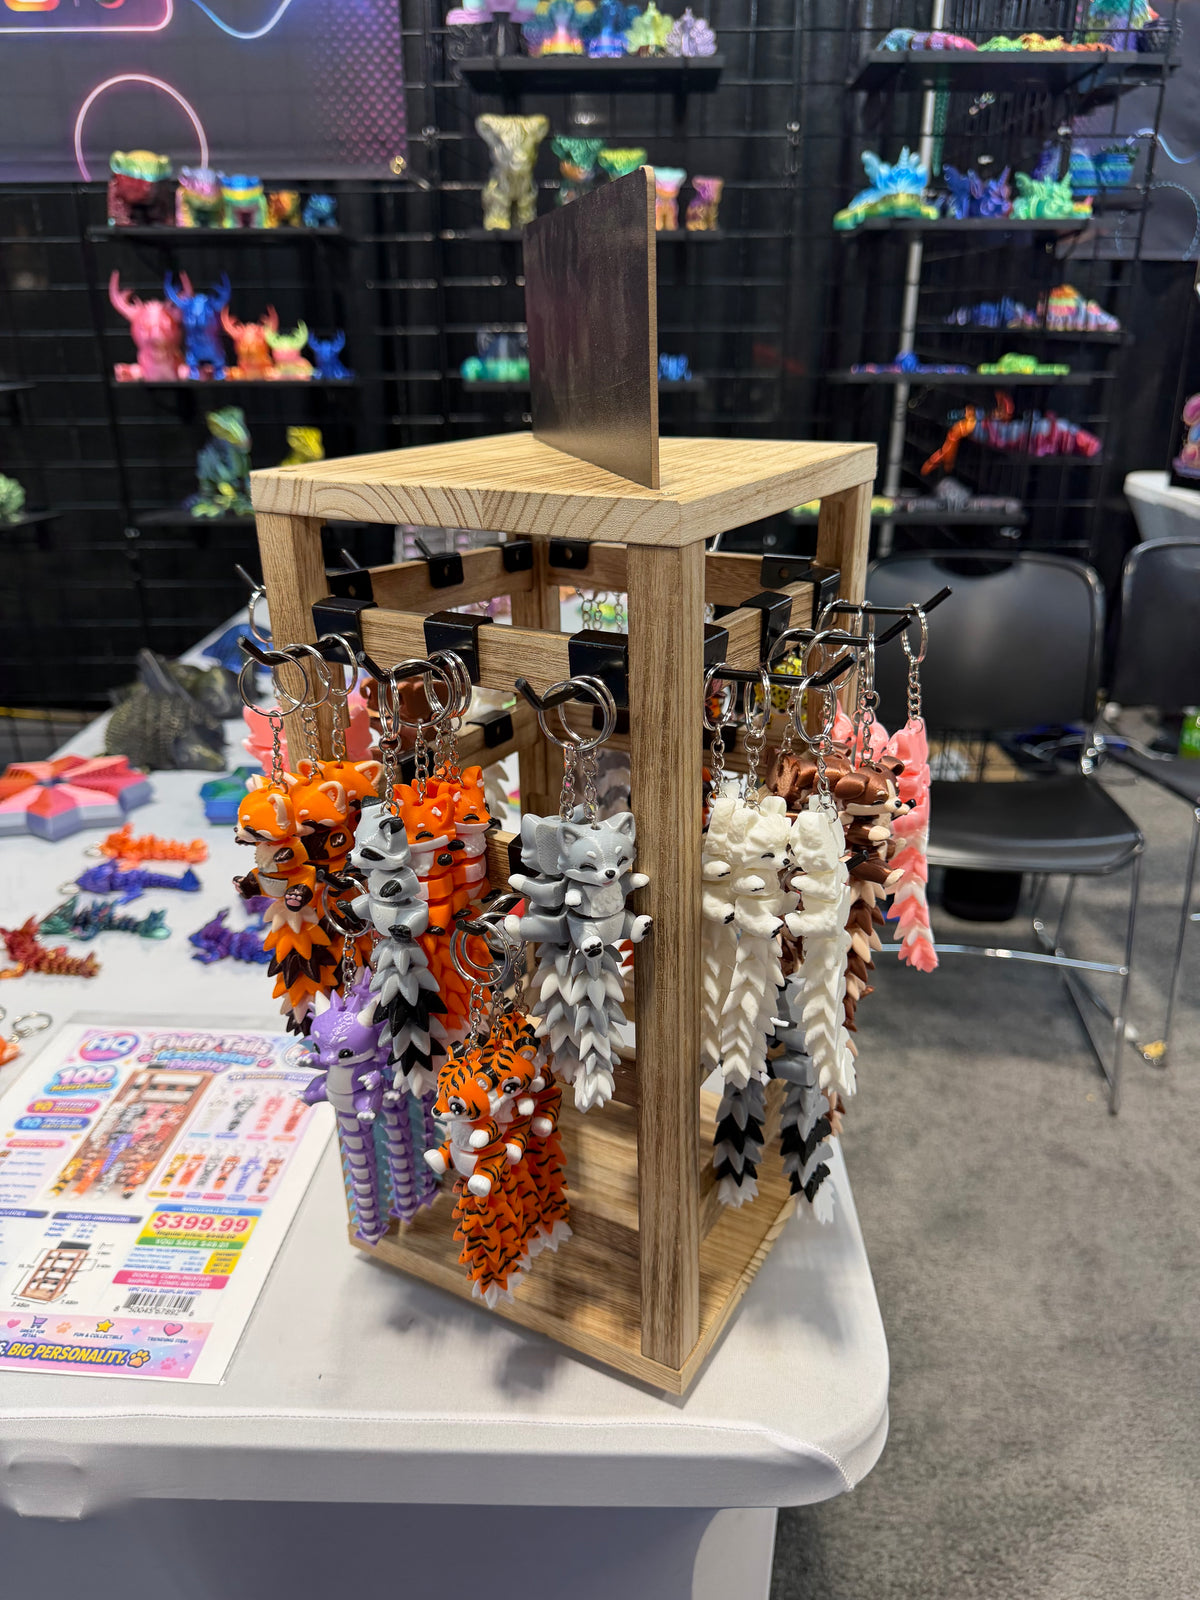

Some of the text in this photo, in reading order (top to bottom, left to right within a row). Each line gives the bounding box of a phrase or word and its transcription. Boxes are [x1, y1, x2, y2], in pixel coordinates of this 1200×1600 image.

[59, 1065, 116, 1085] 100
[153, 1213, 250, 1233] $399.99
[7, 1343, 33, 1356] BIG
[33, 1345, 126, 1365] PERSONALITY.
